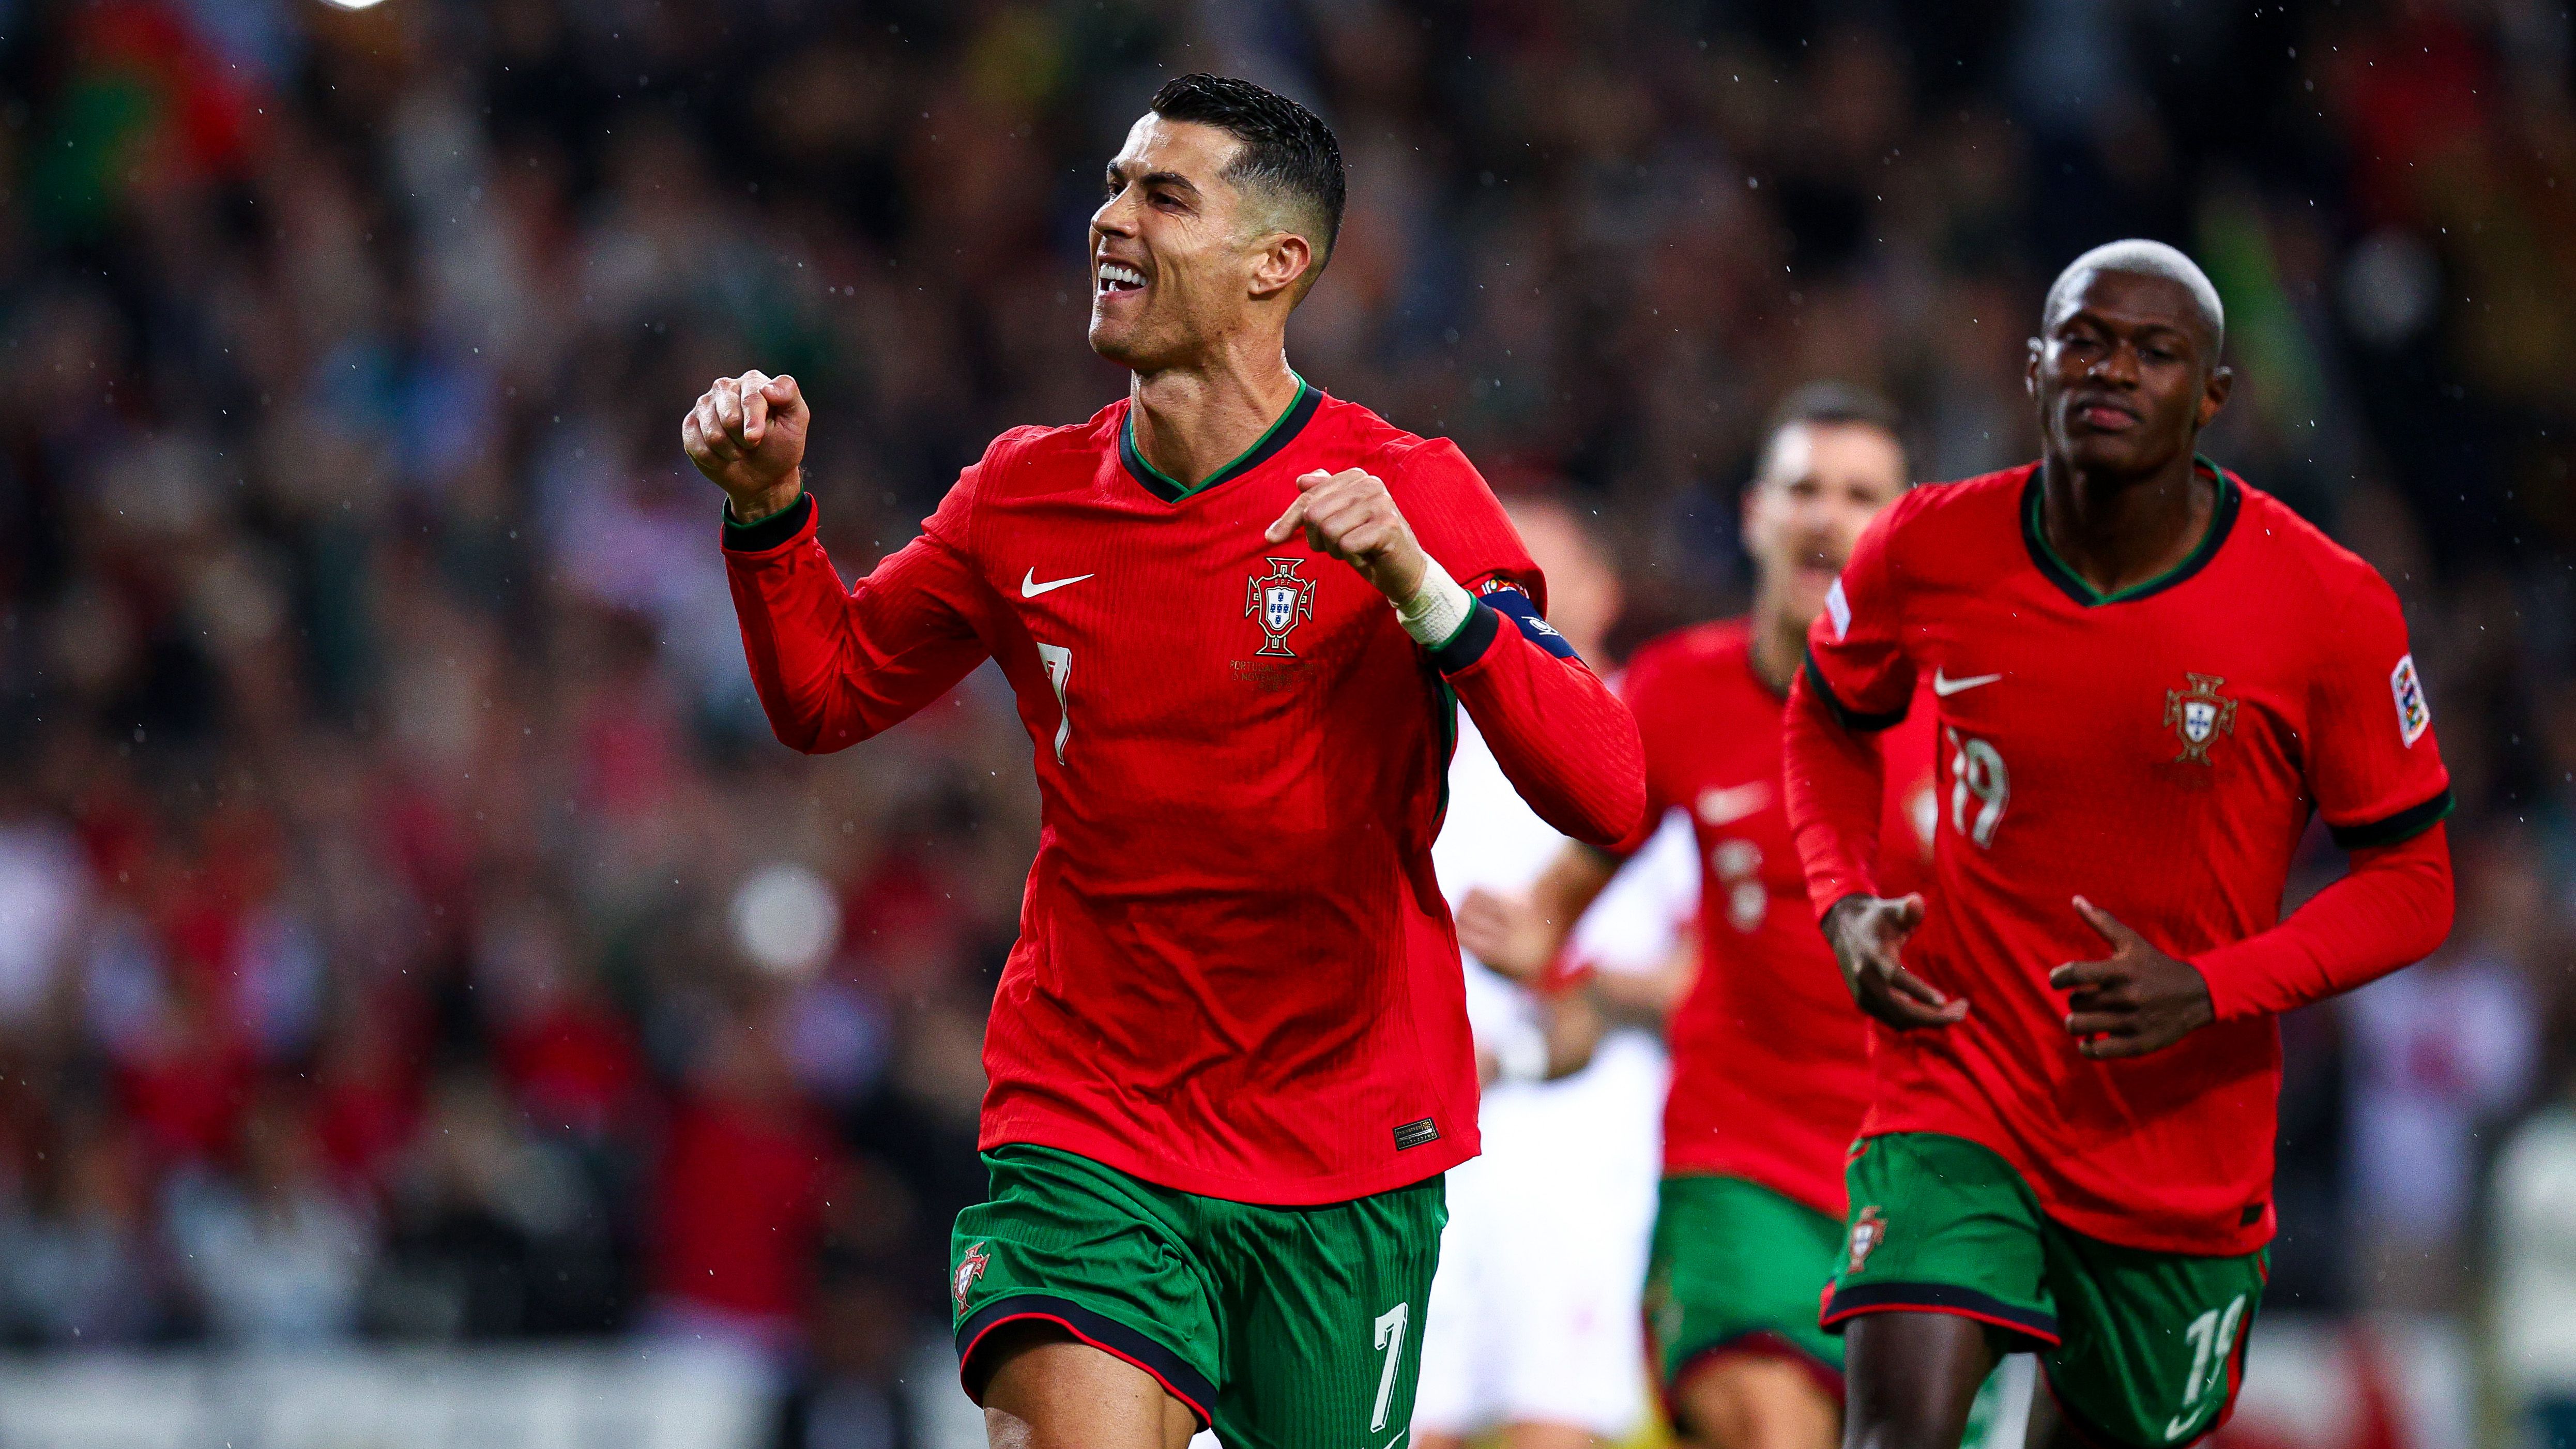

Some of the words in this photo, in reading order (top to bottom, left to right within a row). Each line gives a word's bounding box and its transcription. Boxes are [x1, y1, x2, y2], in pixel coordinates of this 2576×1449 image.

[1036, 642, 1072, 766] 7
[1230, 660, 1275, 673] PORTUGAL
[1946, 725, 2011, 850] 19
[1370, 1302, 1408, 1433] 7
